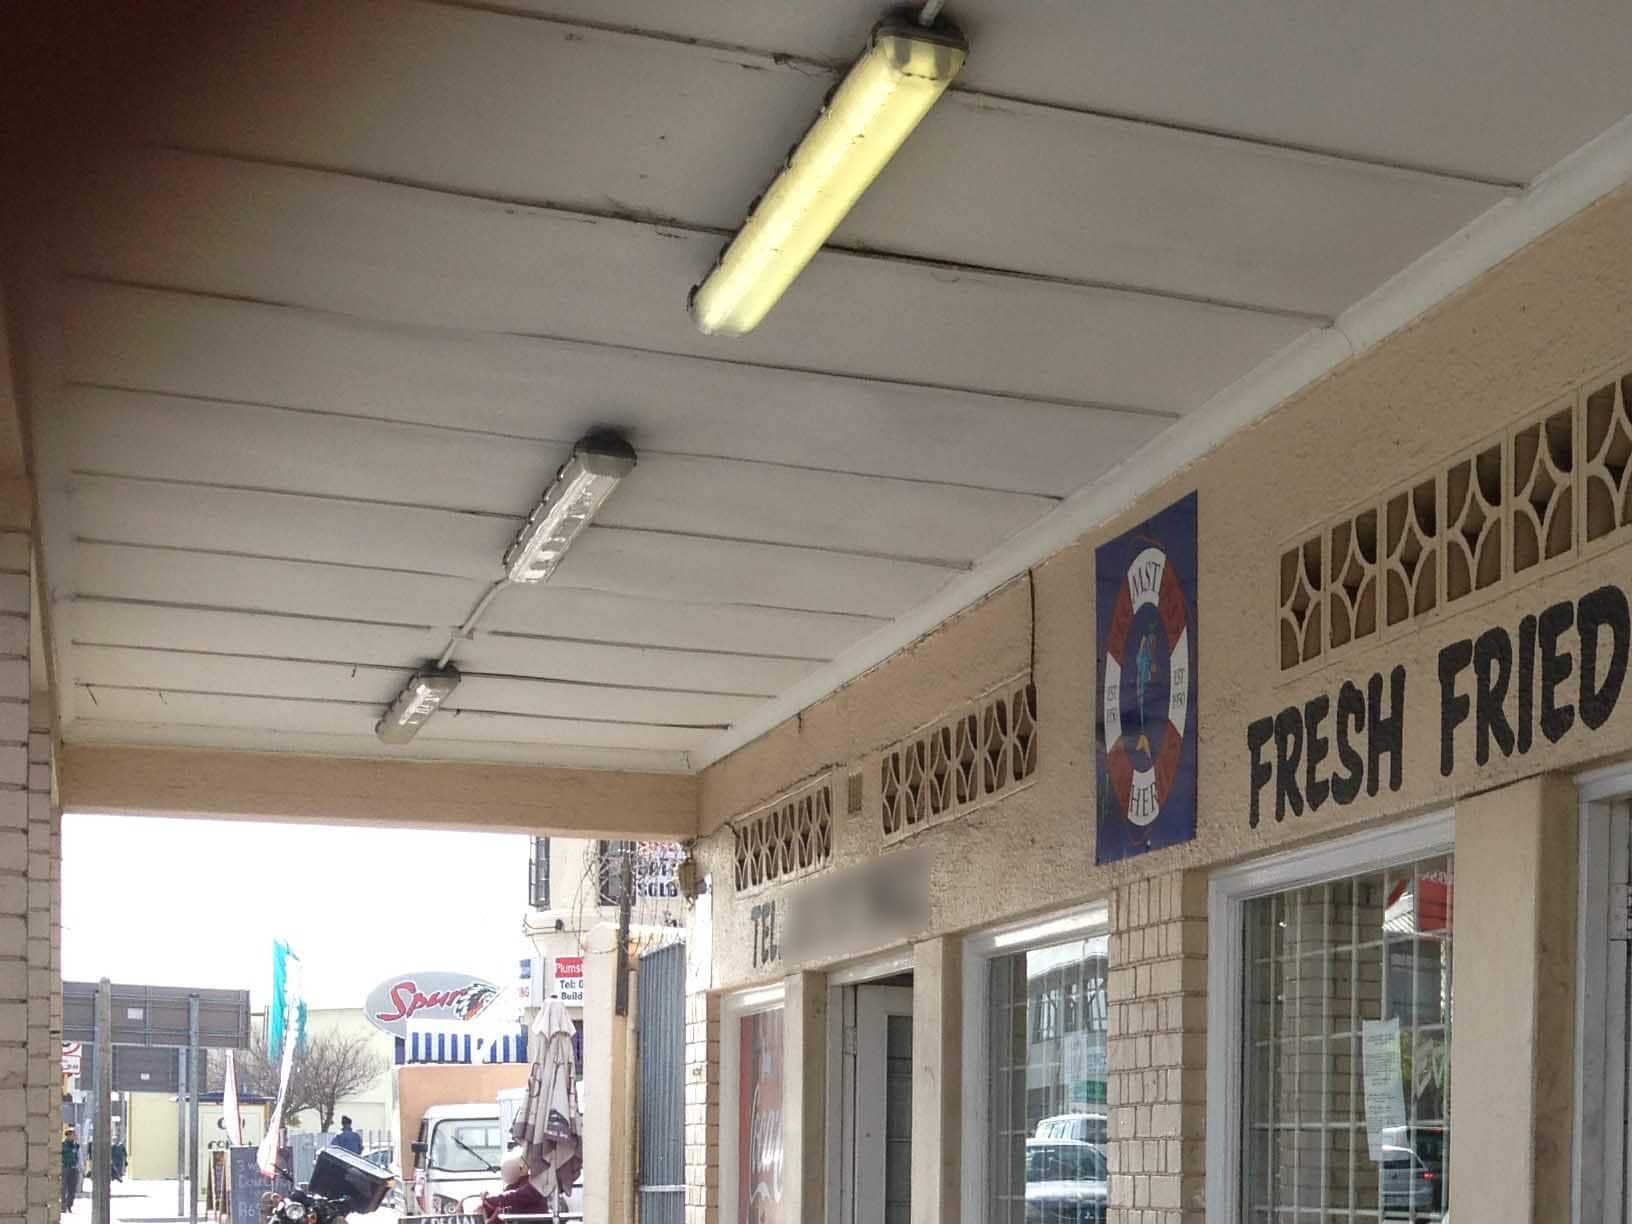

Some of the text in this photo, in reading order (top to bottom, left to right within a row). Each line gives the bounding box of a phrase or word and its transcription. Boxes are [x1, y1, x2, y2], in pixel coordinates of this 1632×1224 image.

[1247, 665, 1406, 829] FRESH
[1438, 584, 1630, 777] FRIED
[556, 963, 584, 973] Plums
[376, 980, 470, 1021] Spur
